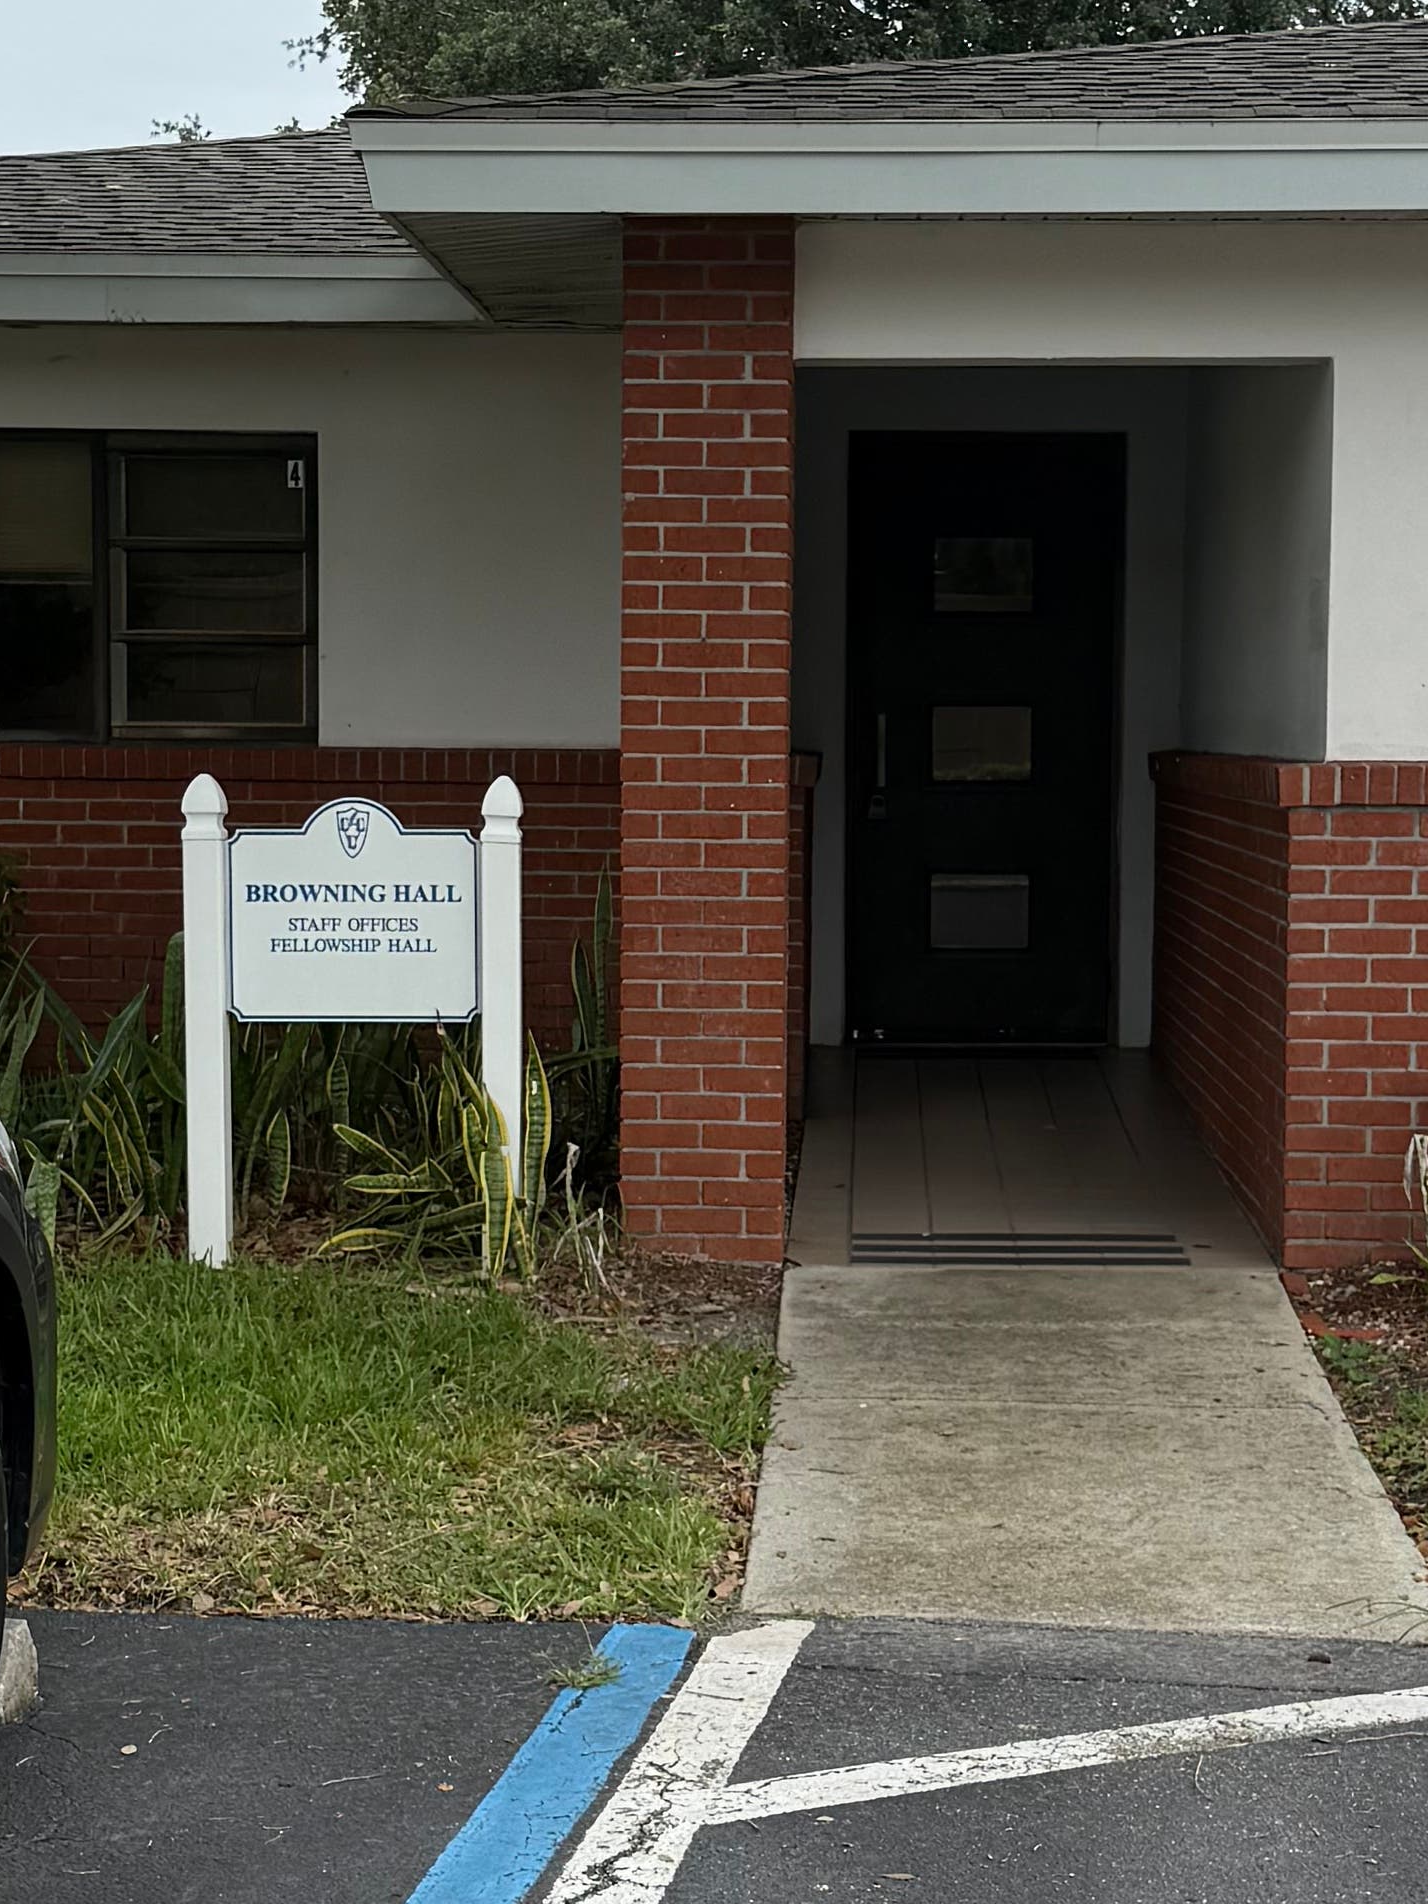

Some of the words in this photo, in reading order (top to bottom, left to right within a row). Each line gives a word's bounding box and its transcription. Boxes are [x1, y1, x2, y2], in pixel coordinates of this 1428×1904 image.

[290, 461, 301, 487] 4
[245, 884, 386, 903] BROWNING
[394, 884, 462, 903] HALL
[288, 917, 341, 932] STAFF
[348, 917, 419, 932] OFFICES
[270, 938, 381, 953] FELLOWSHIP
[388, 938, 438, 953] HALL
